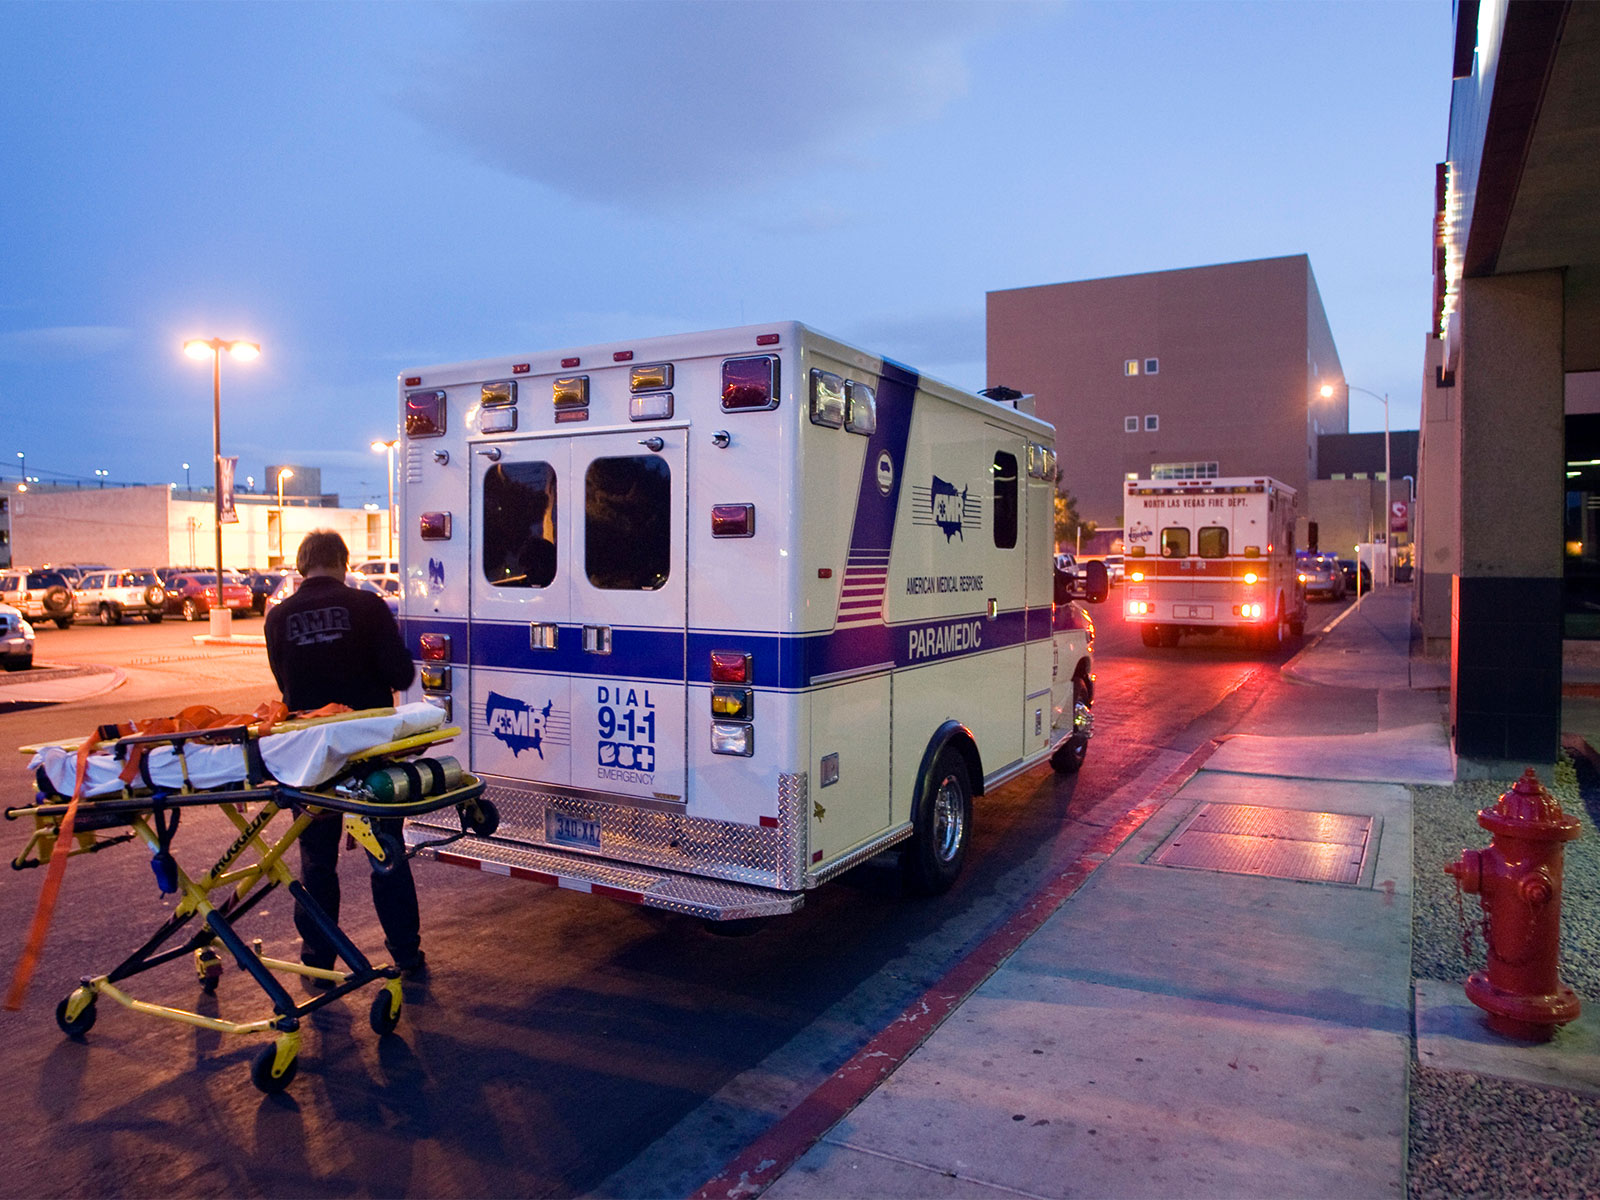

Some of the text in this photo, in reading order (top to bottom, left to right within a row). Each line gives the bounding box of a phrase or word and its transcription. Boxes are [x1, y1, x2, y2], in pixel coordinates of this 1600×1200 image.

[932, 493, 964, 524] AMR
[1143, 498, 1248, 508] NORTH LAS VEGAS FIRE DEPT.
[906, 575, 983, 595] AMERICAN MEDICAL RESPONSE
[287, 606, 351, 641] AMR
[909, 621, 982, 660] PARAMEDIC
[598, 686, 655, 708] DIAL
[488, 707, 547, 740] AMR
[598, 706, 655, 743] 9-1-1
[597, 767, 656, 785] EMERGENCY
[213, 813, 262, 873] RUGGED
